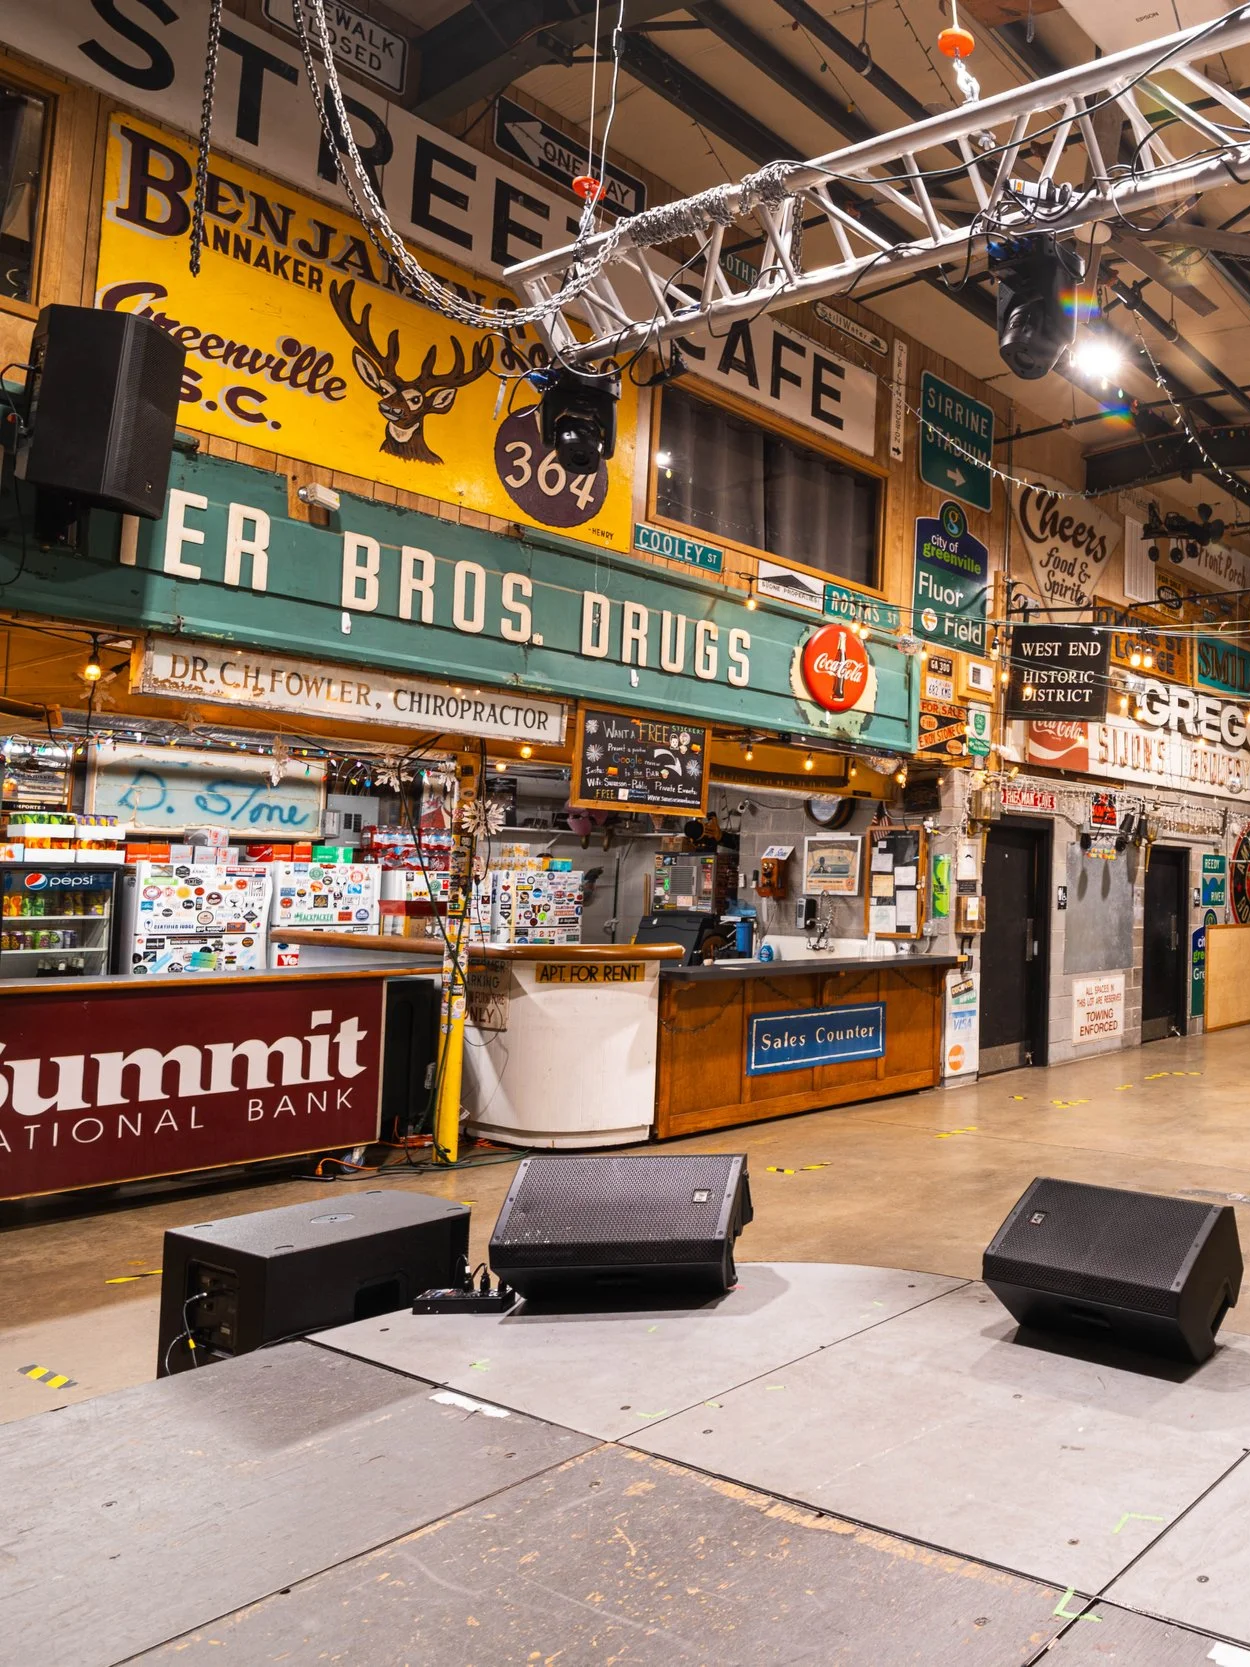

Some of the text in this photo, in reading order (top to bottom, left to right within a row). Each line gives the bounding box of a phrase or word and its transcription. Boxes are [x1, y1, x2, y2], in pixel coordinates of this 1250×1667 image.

[543, 140, 583, 173] ONE
[101, 282, 347, 401] Greenville
[927, 387, 988, 439] SIRRINE
[926, 421, 988, 471] STADIUM
[503, 440, 597, 511] 364
[1020, 482, 1107, 563] Cheers
[638, 526, 717, 564] COOLEY ST
[931, 534, 959, 553] city of
[923, 543, 982, 575] greenville
[1078, 562, 1091, 584] &
[1224, 560, 1248, 587] Porch
[919, 571, 963, 608] Fluor
[341, 530, 750, 687] BROS. DRUGS
[888, 611, 897, 625] ST
[944, 613, 983, 646] Field
[1022, 642, 1101, 656] WEST END
[1023, 670, 1095, 684] HISTORIC
[170, 652, 215, 686] DR.
[393, 688, 549, 732] CHIROPRACTOR
[1023, 688, 1093, 703] DISTRICT
[922, 701, 965, 719] FOR SALE
[603, 720, 670, 744] WANT A FREE
[612, 752, 643, 768] Google
[119, 769, 175, 814] D.
[595, 788, 615, 799] FREE
[654, 780, 676, 793] Private
[1204, 859, 1220, 869] REEDY
[50, 875, 93, 887] pepsi
[540, 964, 640, 981] APT. FOR RENT
[1077, 999, 1086, 1007] THIS
[1104, 993, 1122, 1003] RESERVED
[1095, 985, 1109, 994] SPACES
[953, 1018, 972, 1031] VISA
[1086, 1008, 1114, 1022] TOWING
[761, 1024, 875, 1051] Sales Counter
[1079, 1020, 1118, 1036] ENFORCED
[0, 1009, 368, 1117] ummit
[247, 1087, 353, 1122] BANK
